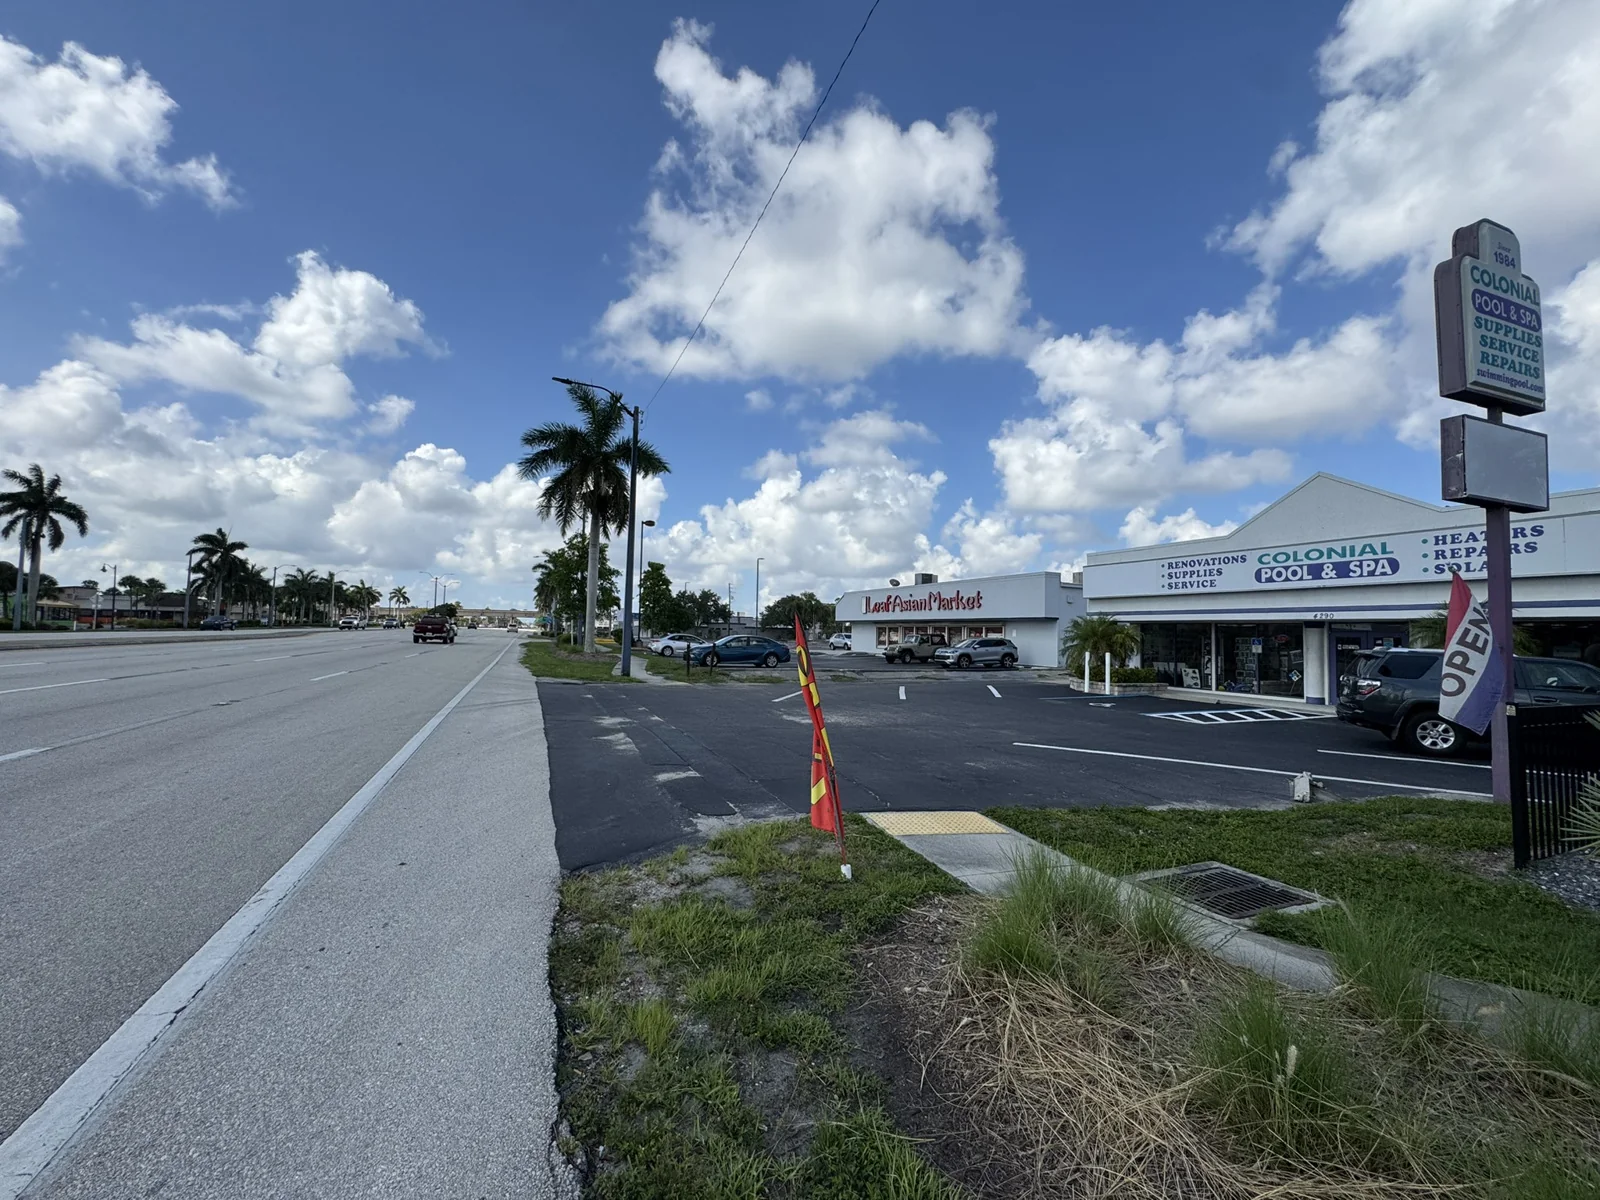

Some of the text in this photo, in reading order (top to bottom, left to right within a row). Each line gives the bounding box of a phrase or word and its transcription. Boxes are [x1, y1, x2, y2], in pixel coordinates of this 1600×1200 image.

[1493, 250, 1516, 269] 1984
[1470, 265, 1540, 307] COLONIAL
[1475, 293, 1539, 330] POOL & SPA
[1474, 315, 1542, 348] SUPPLIES
[1479, 334, 1539, 363] SERVICE
[1480, 351, 1540, 380] REPAIRS
[1477, 368, 1544, 394] swimmingpool.com
[1433, 525, 1545, 546] HEATRS
[1167, 554, 1247, 570] RENOVATIONS
[1257, 541, 1394, 565] COLONIAL
[1433, 541, 1538, 560] REPARS
[1167, 567, 1223, 580] SUPPLIES
[1261, 559, 1393, 582] POOL & SPA
[1434, 561, 1488, 575] SOLA
[1167, 579, 1217, 590] SERVICE
[892, 594, 927, 612] Asian
[928, 590, 983, 611] Market
[1440, 606, 1490, 697] OPEN
